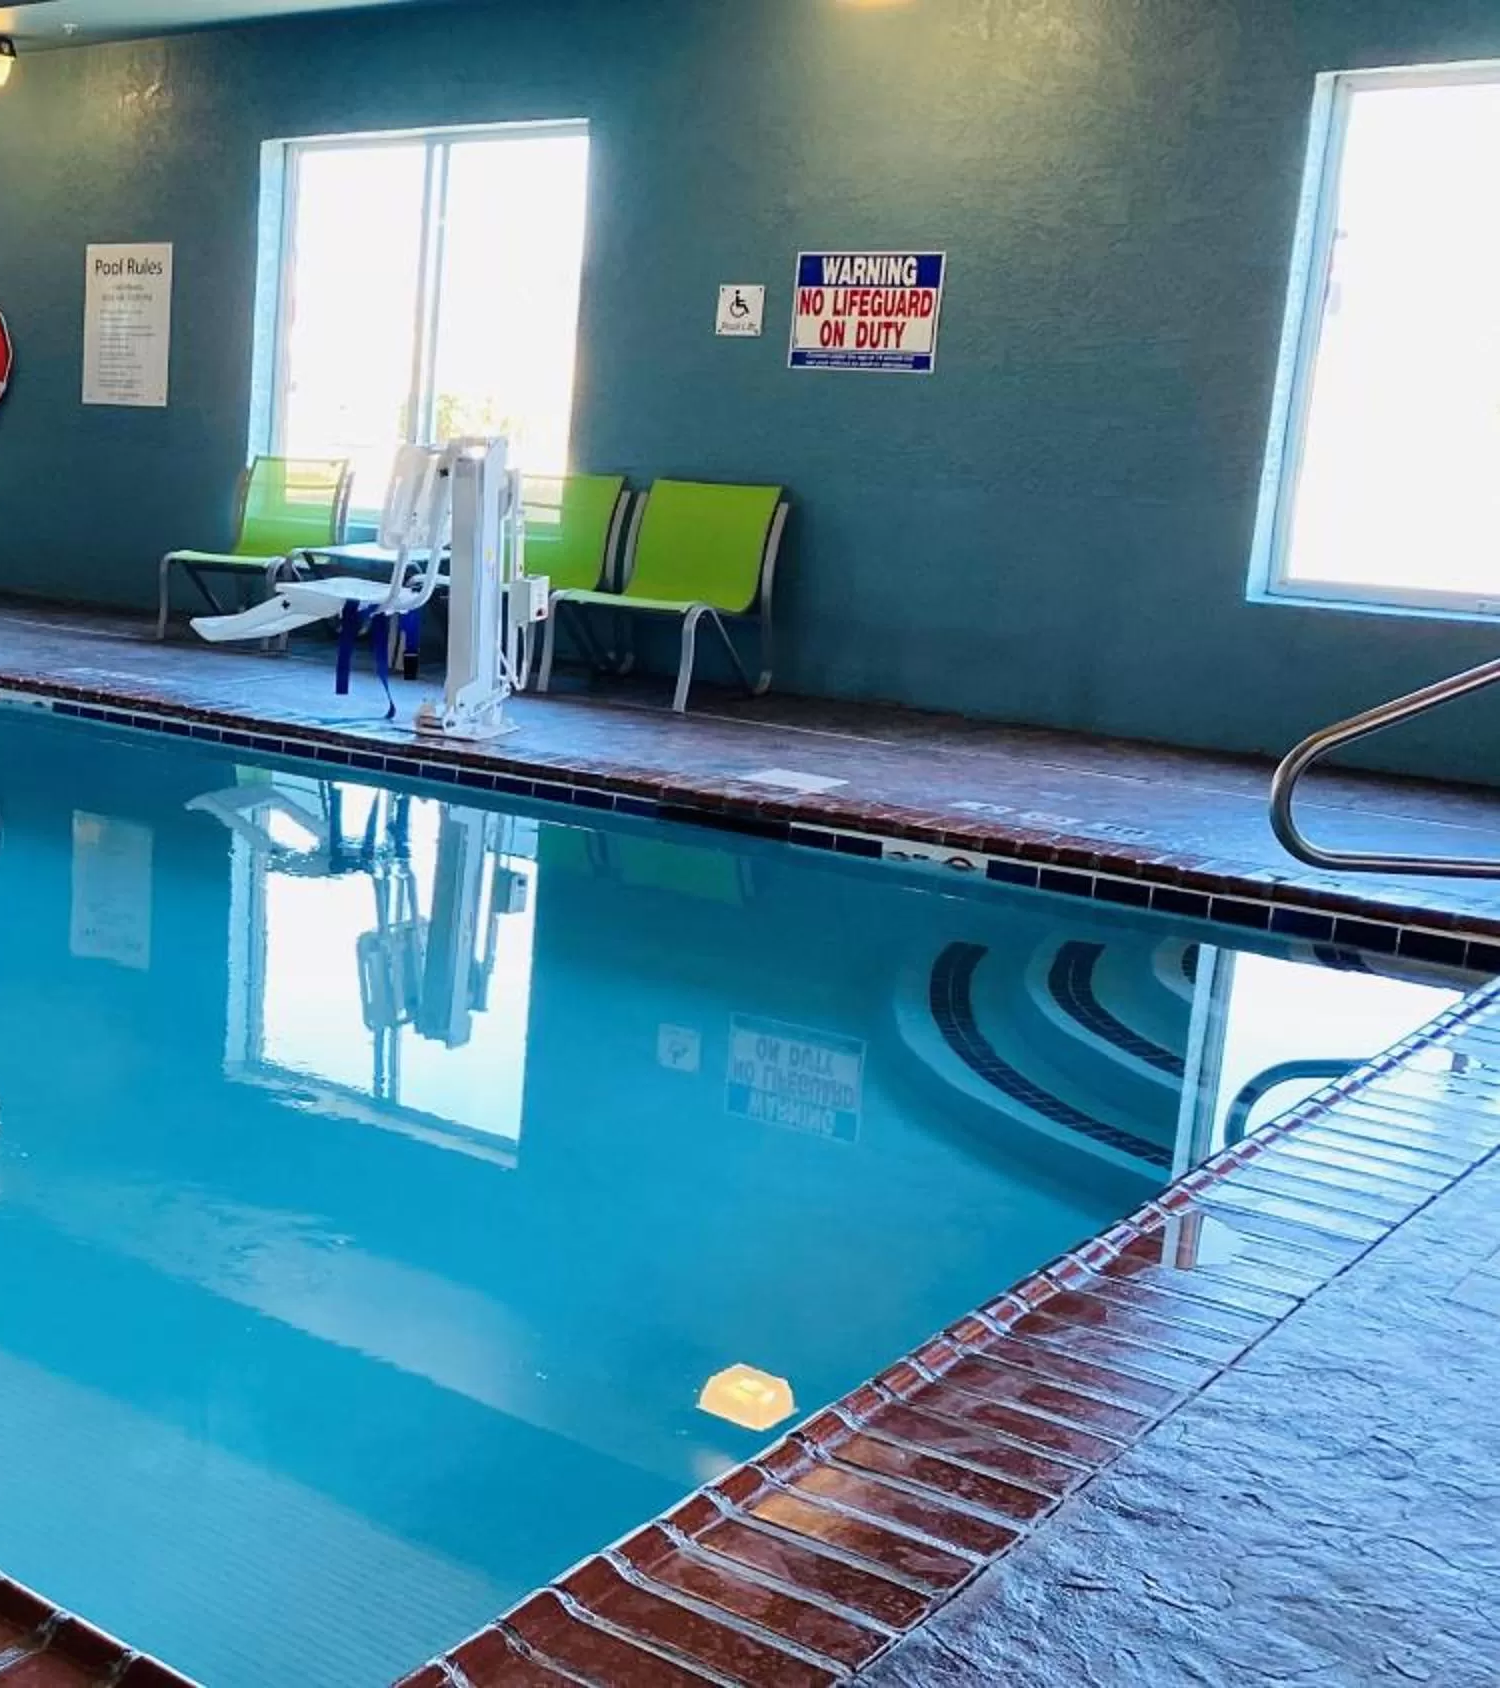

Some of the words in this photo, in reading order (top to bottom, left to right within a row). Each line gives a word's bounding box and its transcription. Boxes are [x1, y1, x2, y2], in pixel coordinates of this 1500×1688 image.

[95, 258, 124, 276] Pool
[127, 257, 163, 275] Rules
[822, 257, 918, 286] WARNING
[798, 289, 824, 316] NO
[832, 289, 933, 318] LIFEGUARD
[820, 320, 845, 348] ON
[855, 321, 907, 349] DUTY
